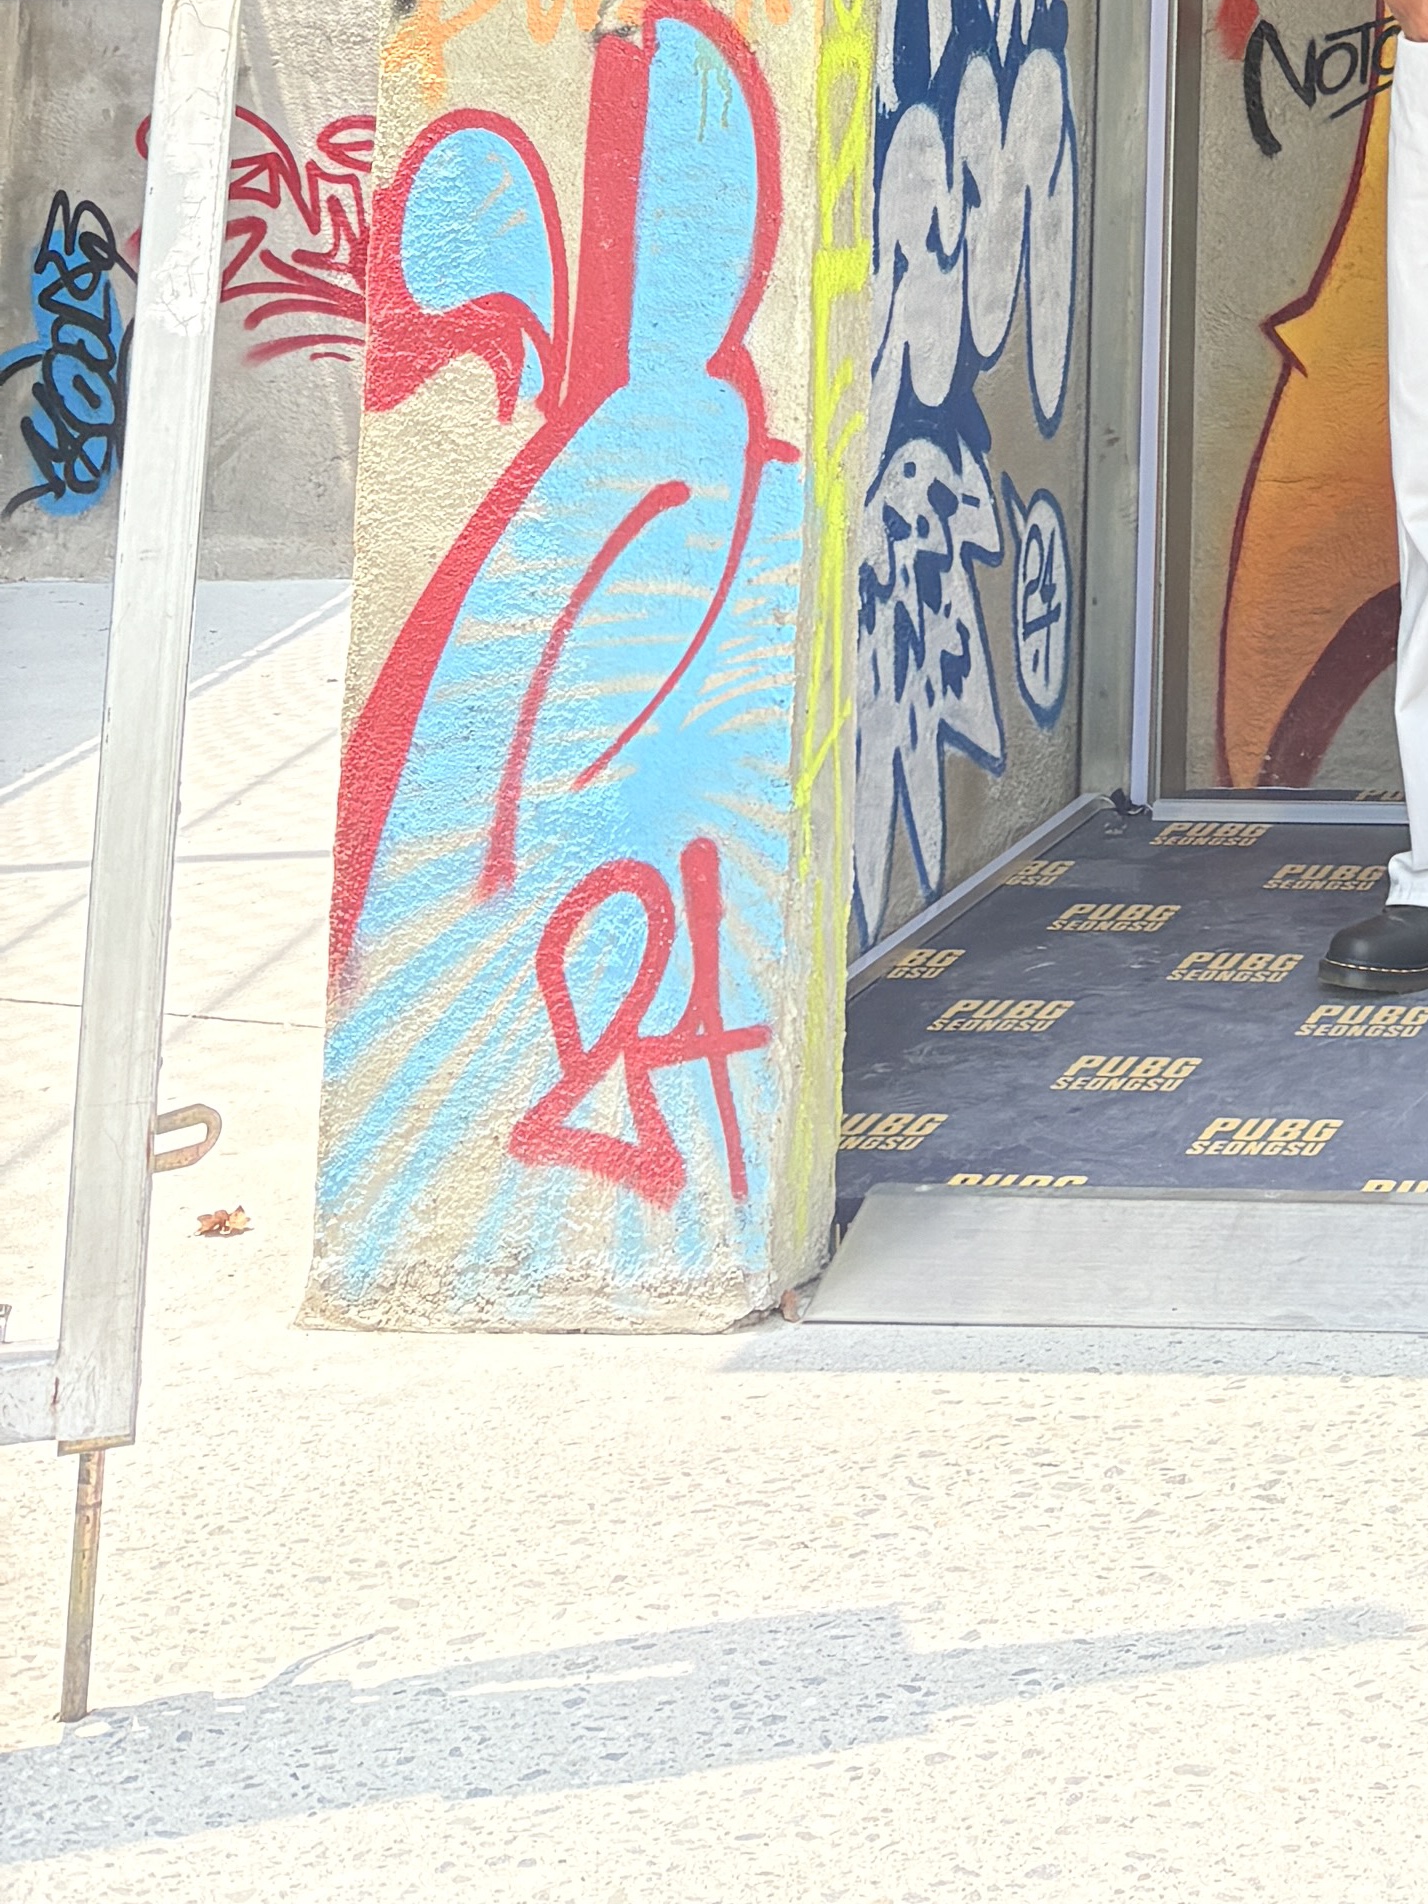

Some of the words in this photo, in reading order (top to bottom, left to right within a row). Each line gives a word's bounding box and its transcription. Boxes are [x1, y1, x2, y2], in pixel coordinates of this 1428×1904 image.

[1161, 821, 1269, 838] PUBG
[1148, 834, 1261, 848] SEONGSU
[1018, 859, 1076, 876] BG
[1274, 863, 1388, 882] PUBG
[1262, 878, 1375, 892] SEONGSU
[1063, 903, 1182, 923] PUBG
[1046, 918, 1168, 933] SEONGSU
[894, 948, 967, 968] BG
[1176, 951, 1304, 972] PUBG
[1166, 968, 1290, 984] SEONGSU
[941, 998, 1075, 1020] PUBG
[926, 1016, 1063, 1032] SEONGSU
[1294, 1022, 1423, 1039] SEONGSU
[1065, 1054, 1203, 1079] PUBG
[1050, 1074, 1184, 1092] SEONGSU
[840, 1112, 949, 1137] UBG
[1197, 1116, 1344, 1143] PUBG
[1185, 1139, 1328, 1157] SEONGSU
